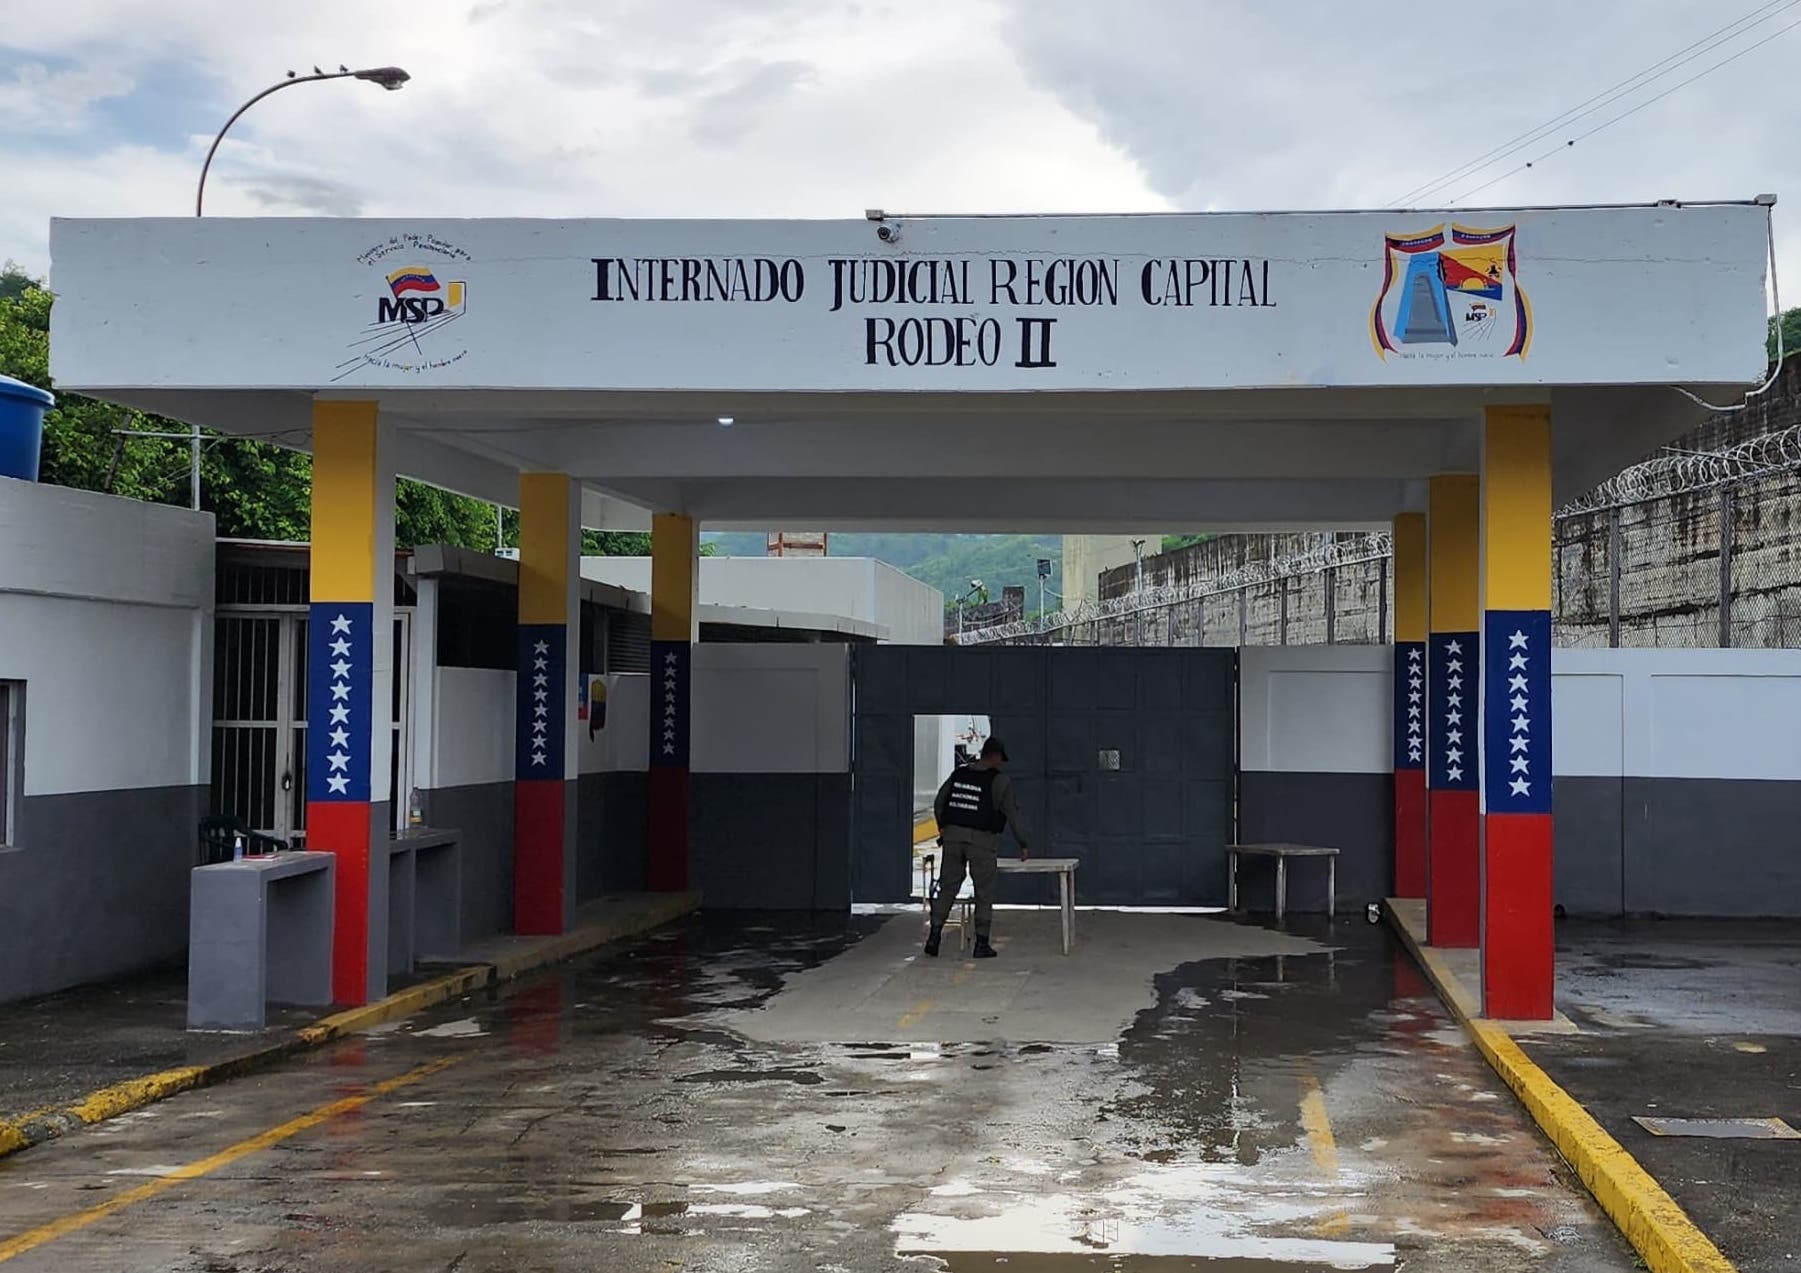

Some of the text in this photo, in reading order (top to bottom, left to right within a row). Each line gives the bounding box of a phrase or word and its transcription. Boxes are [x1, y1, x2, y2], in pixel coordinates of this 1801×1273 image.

[590, 258, 1277, 312] INTERNADO JUDICIAL REGION CAPITAL
[864, 317, 1058, 368] RODEO II
